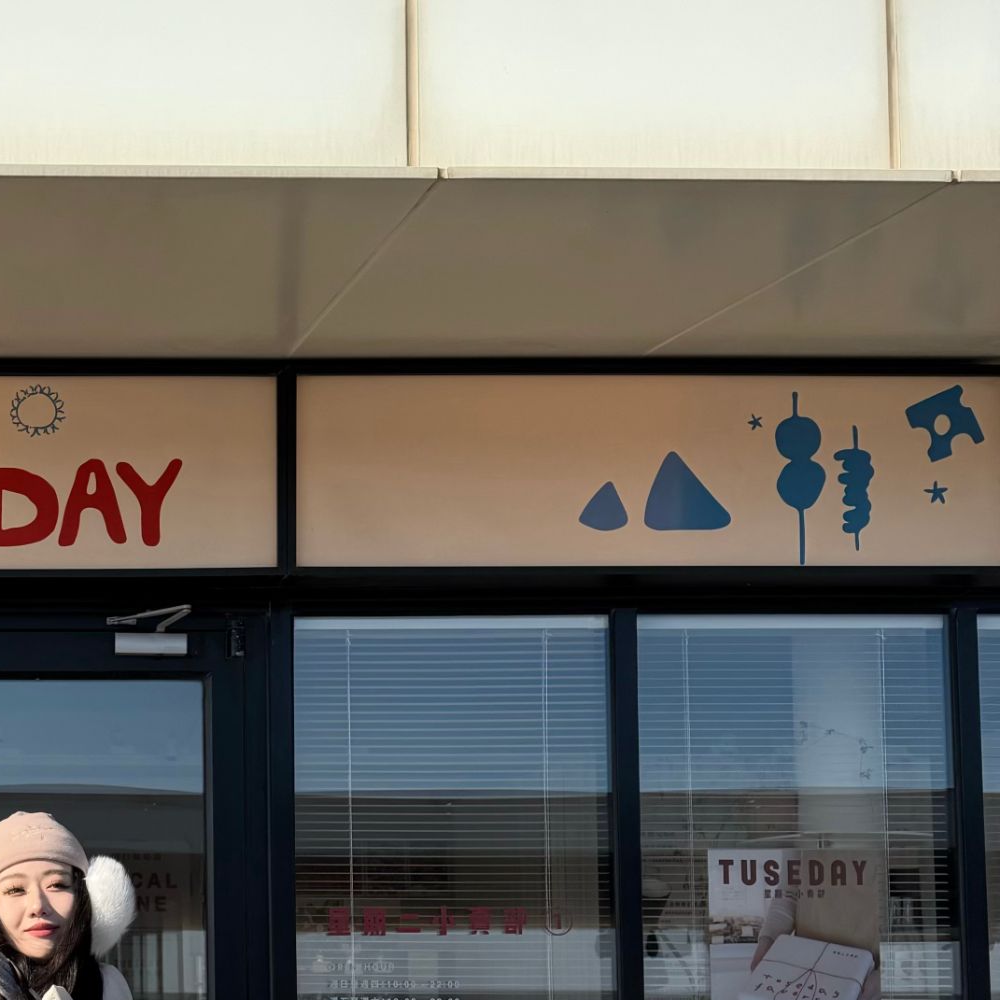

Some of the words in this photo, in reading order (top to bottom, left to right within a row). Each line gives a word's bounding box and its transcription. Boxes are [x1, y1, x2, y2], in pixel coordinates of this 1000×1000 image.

[132, 872, 178, 889] CAL
[718, 859, 867, 886] TUSEDAY
[136, 895, 167, 912] NE
